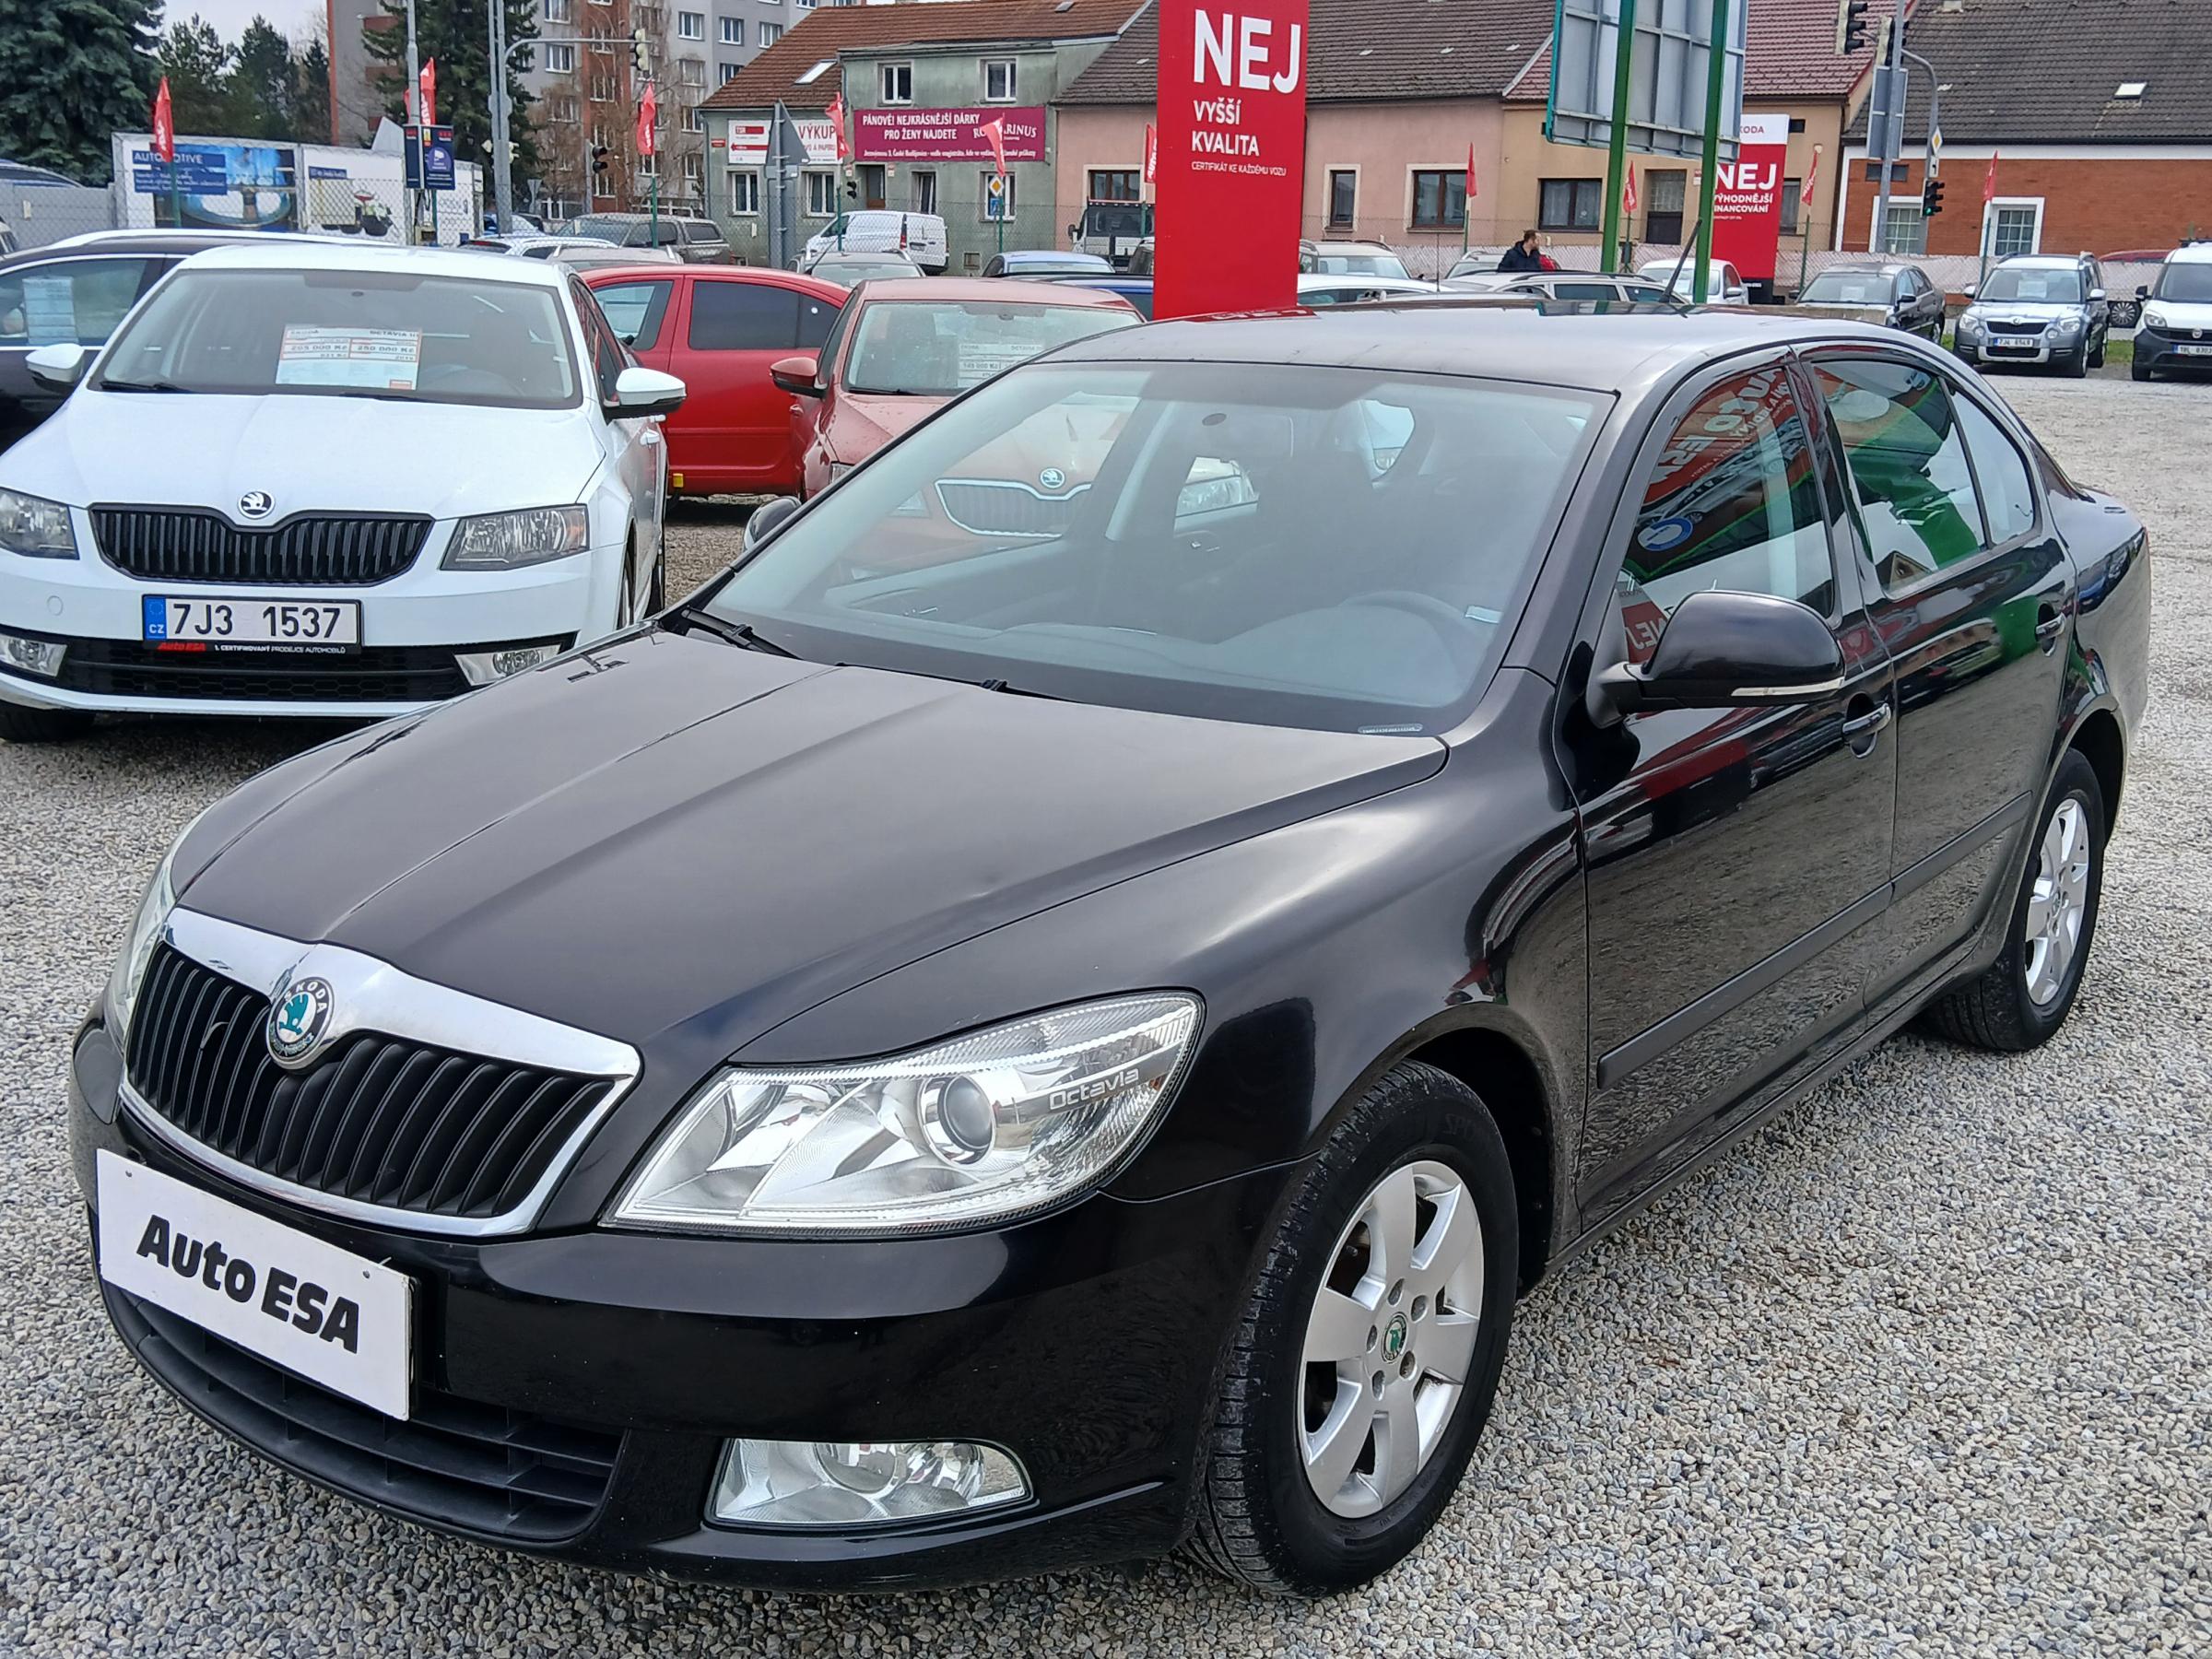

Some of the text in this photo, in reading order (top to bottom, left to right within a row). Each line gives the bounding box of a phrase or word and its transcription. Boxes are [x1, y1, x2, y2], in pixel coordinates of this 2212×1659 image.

[1193, 9, 1301, 94] NEJ
[896, 112, 952, 125] NEJKRÁSNĚJŠÍ
[953, 112, 980, 124] DÁRKY
[1193, 96, 1241, 125] VYŠŠÍ
[798, 123, 836, 139] VÝKUP
[884, 127, 958, 140] PRO ŽENY NAJDETE
[1191, 130, 1260, 157] KVALITA
[134, 152, 204, 164] AUTOOTIVE
[1191, 161, 1228, 172] CERTIFIKÁT
[1229, 163, 1238, 173] KE
[1269, 167, 1287, 177] VOZU
[1715, 163, 1777, 191] NEJ
[148, 623, 165, 635] CZ
[173, 604, 341, 639] 7J3 1537
[1049, 1068, 1139, 1110] Octavia
[136, 1215, 359, 1354] Auto ESA
